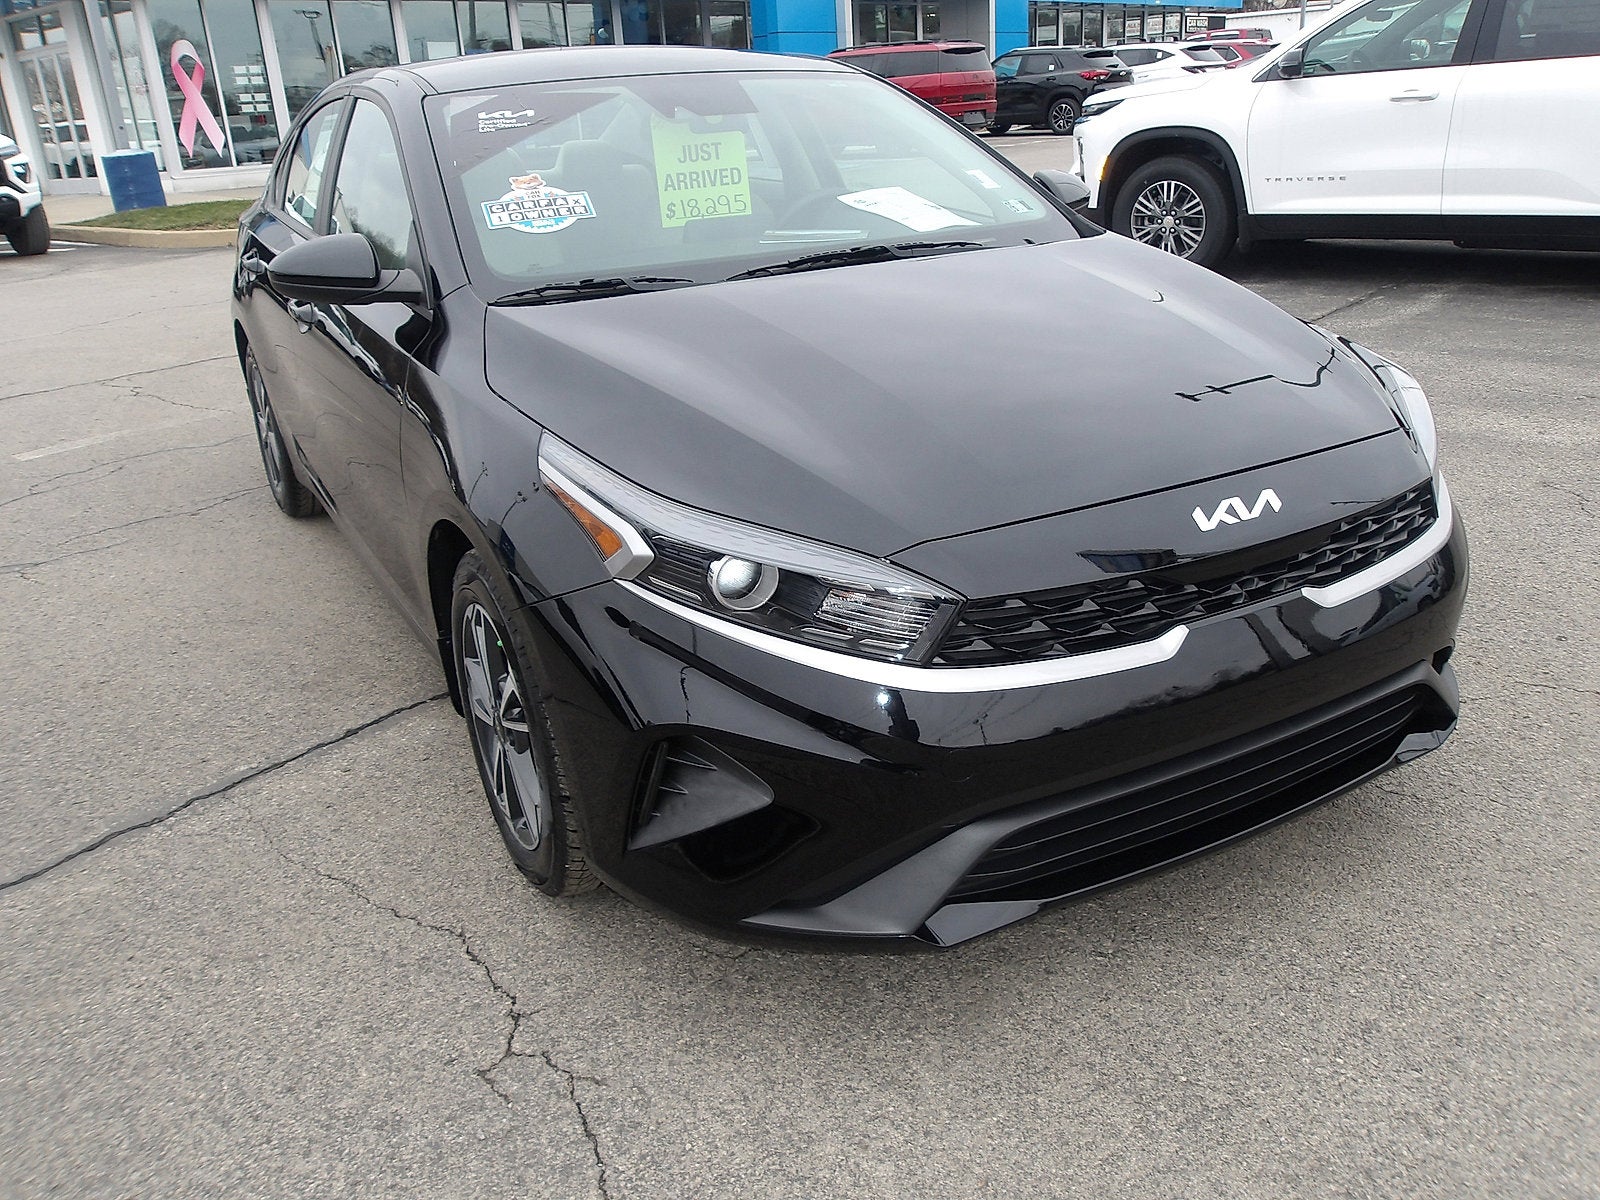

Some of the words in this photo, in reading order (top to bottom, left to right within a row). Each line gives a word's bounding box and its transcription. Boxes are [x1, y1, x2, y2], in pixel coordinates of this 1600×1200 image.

[677, 142, 722, 164] JUST
[664, 167, 742, 191] ARRIVED
[489, 197, 583, 213] CARFAX
[509, 205, 589, 222] OWNER
[666, 194, 747, 220] $18,295
[1191, 488, 1283, 532] KIA
